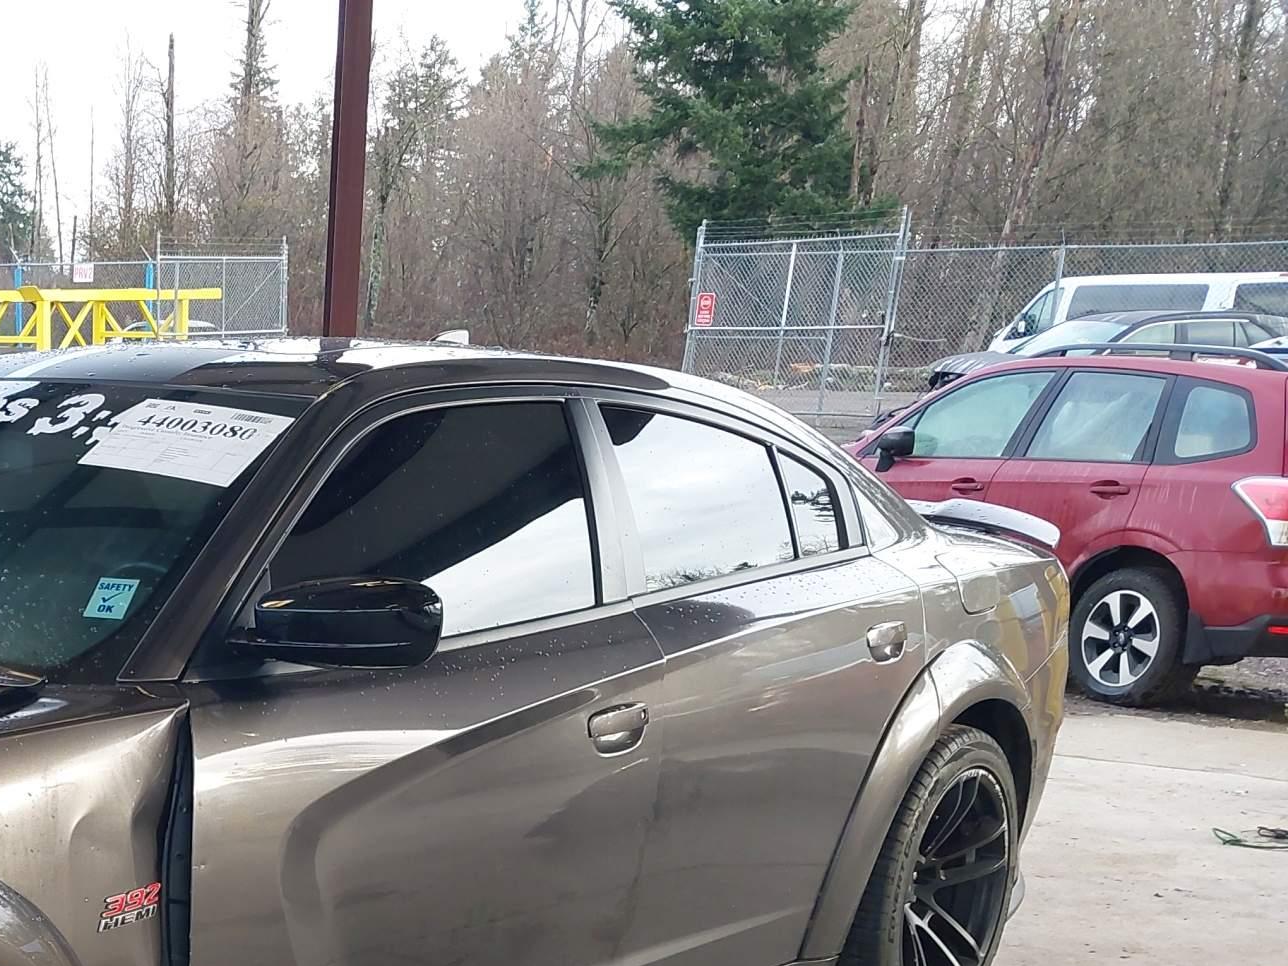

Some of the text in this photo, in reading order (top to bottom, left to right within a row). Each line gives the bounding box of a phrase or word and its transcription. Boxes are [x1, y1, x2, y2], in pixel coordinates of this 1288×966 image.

[138, 414, 258, 441] 44003080
[98, 583, 134, 592] SAFETY
[97, 604, 114, 613] OK
[101, 881, 162, 918] 392
[97, 904, 158, 933] HEMI
